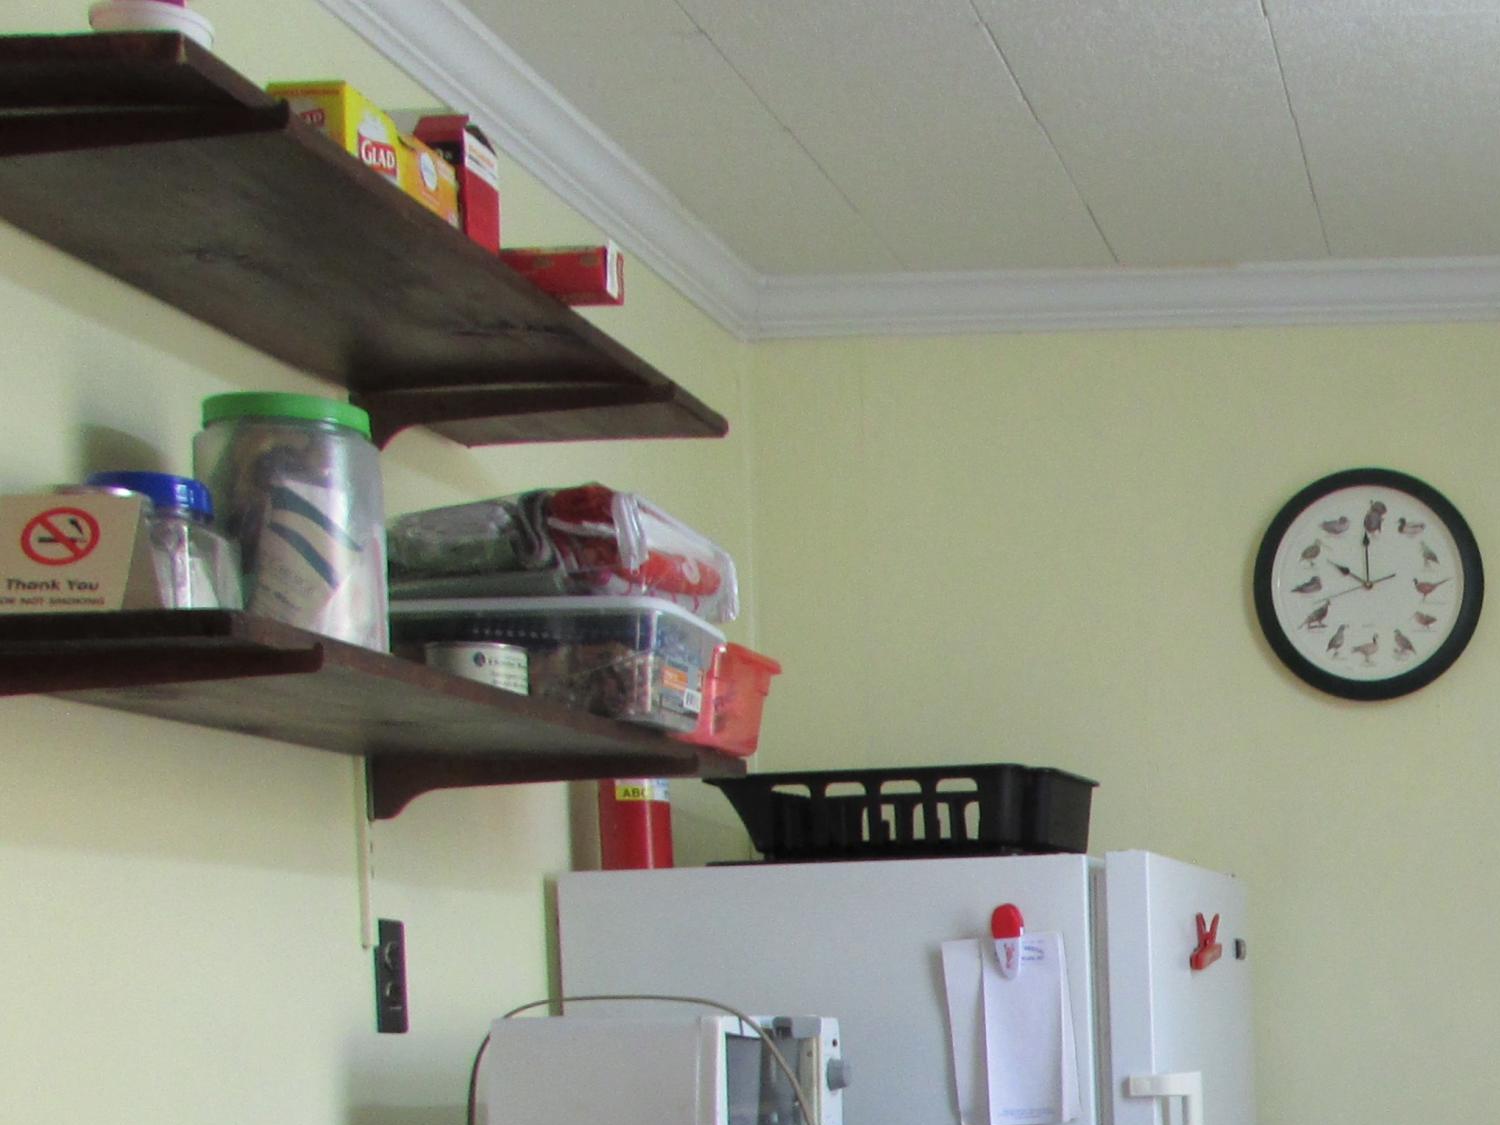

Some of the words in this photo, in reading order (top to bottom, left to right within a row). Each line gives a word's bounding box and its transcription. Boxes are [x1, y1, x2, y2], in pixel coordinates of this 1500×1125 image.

[361, 140, 396, 168] GLAD
[7, 578, 60, 591] Thank
[67, 578, 99, 591] You
